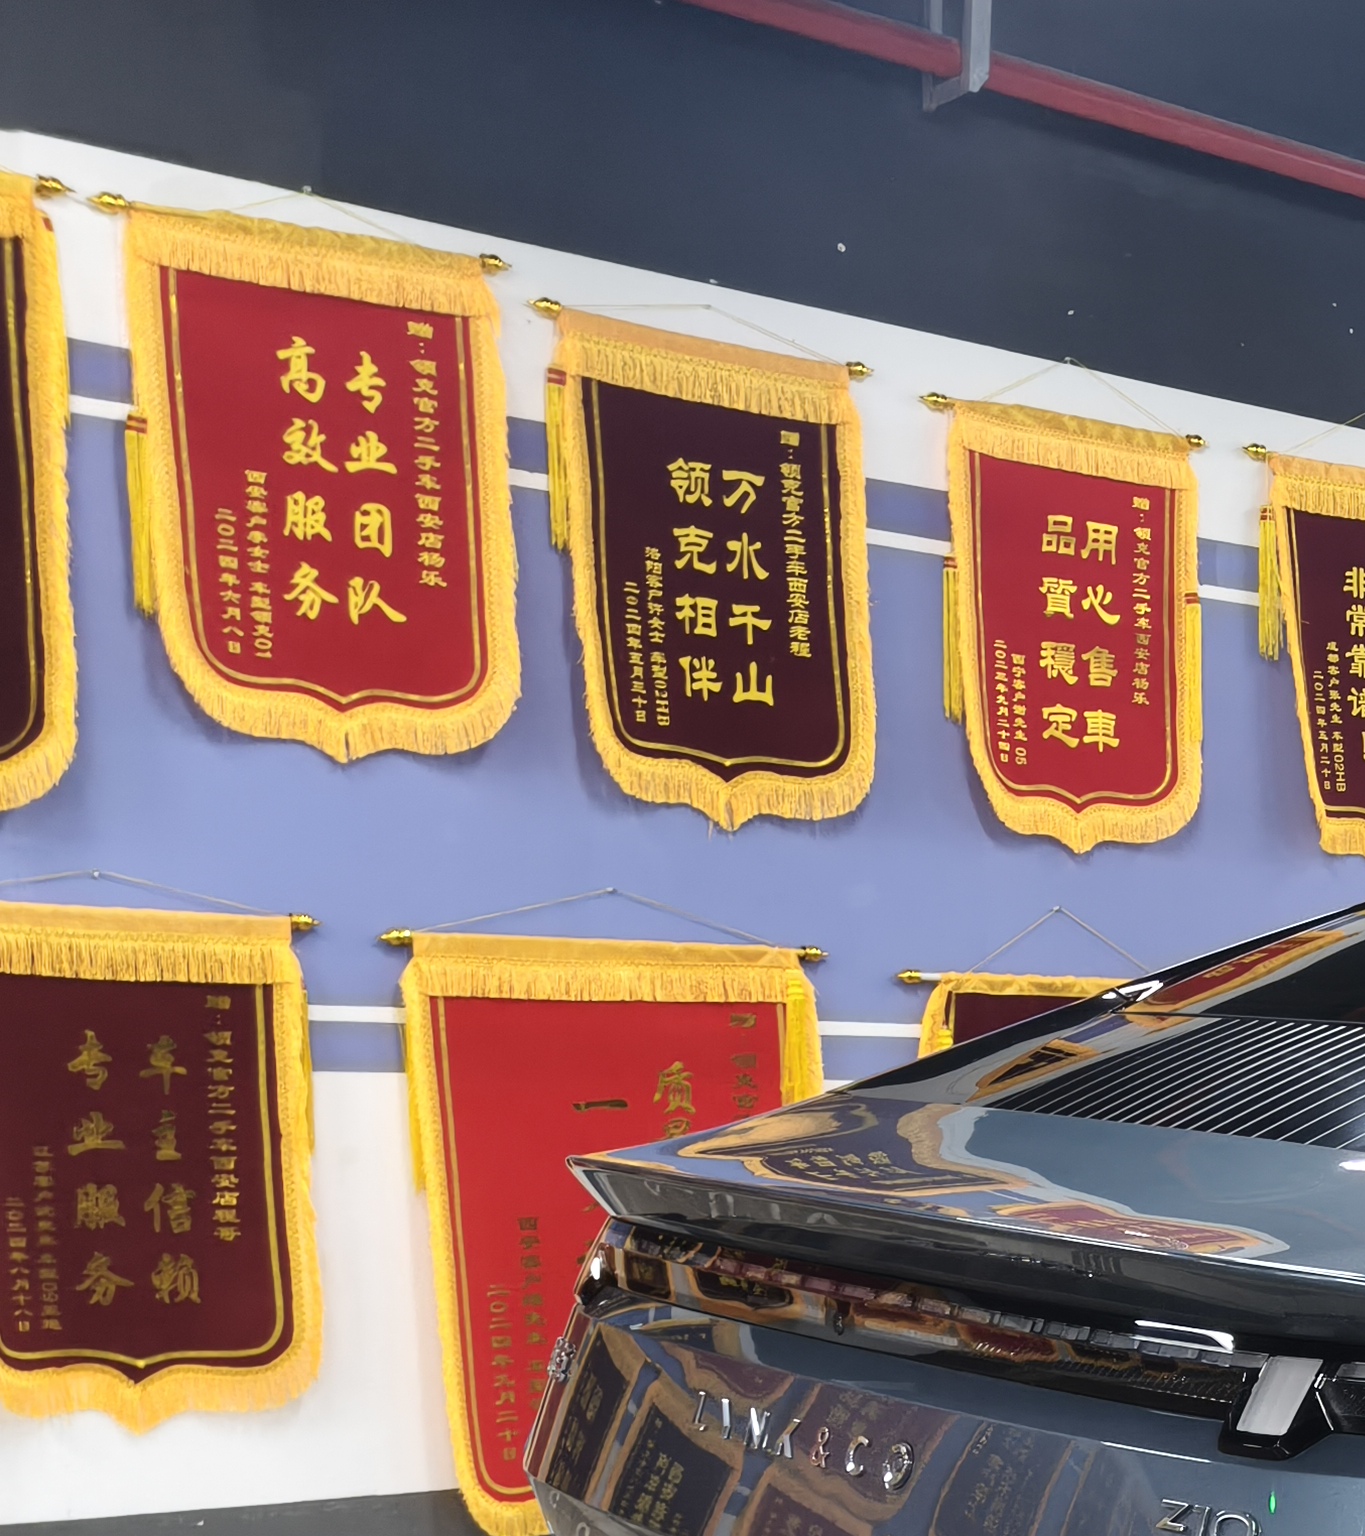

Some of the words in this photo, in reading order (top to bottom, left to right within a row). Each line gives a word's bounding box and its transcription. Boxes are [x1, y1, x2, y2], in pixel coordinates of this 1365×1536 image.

[276, 336, 339, 620] 高效服务
[344, 351, 407, 625] 专业团队
[667, 457, 723, 702] 领克相伴
[722, 469, 775, 706] 万水千山
[1081, 520, 1121, 753] 用心售車
[67, 1029, 134, 1306] 专业服务
